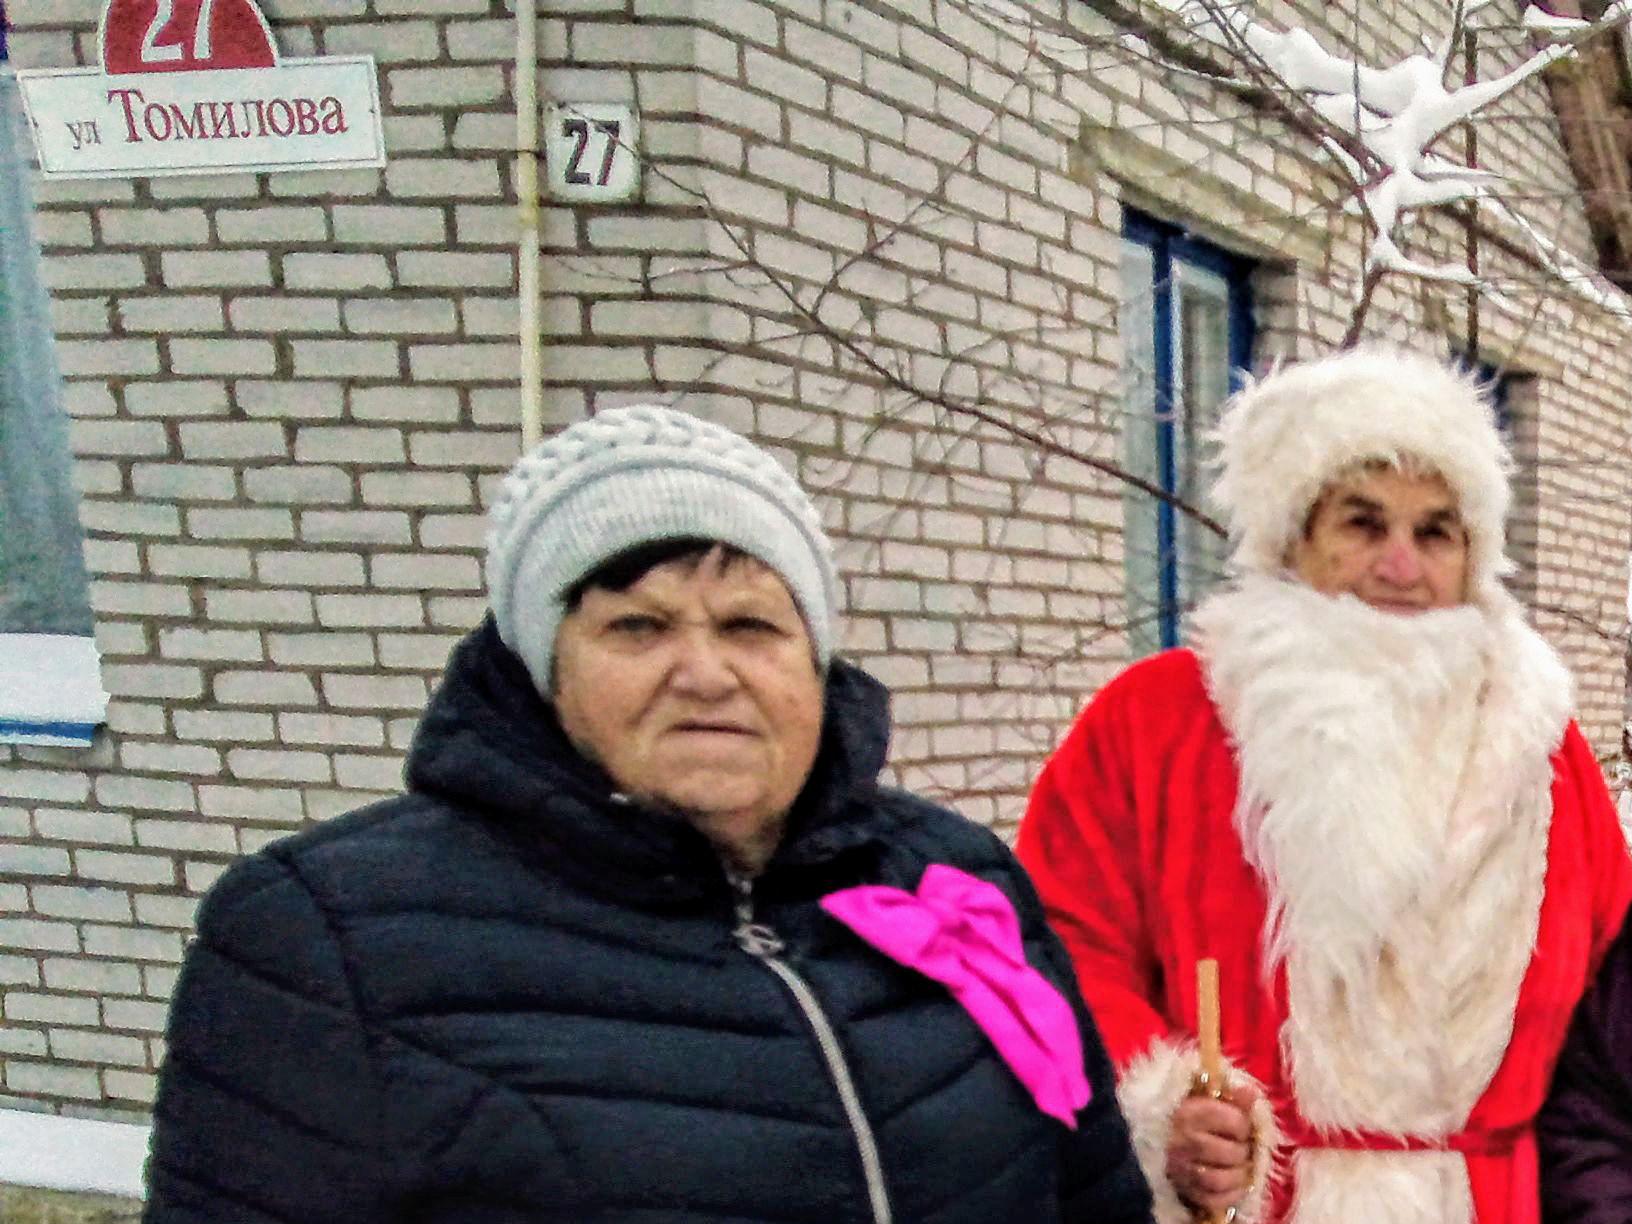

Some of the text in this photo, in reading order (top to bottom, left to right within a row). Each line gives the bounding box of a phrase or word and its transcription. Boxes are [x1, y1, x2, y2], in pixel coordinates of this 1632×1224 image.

[65, 88, 348, 150] ул Томилова
[561, 118, 620, 186] 27
